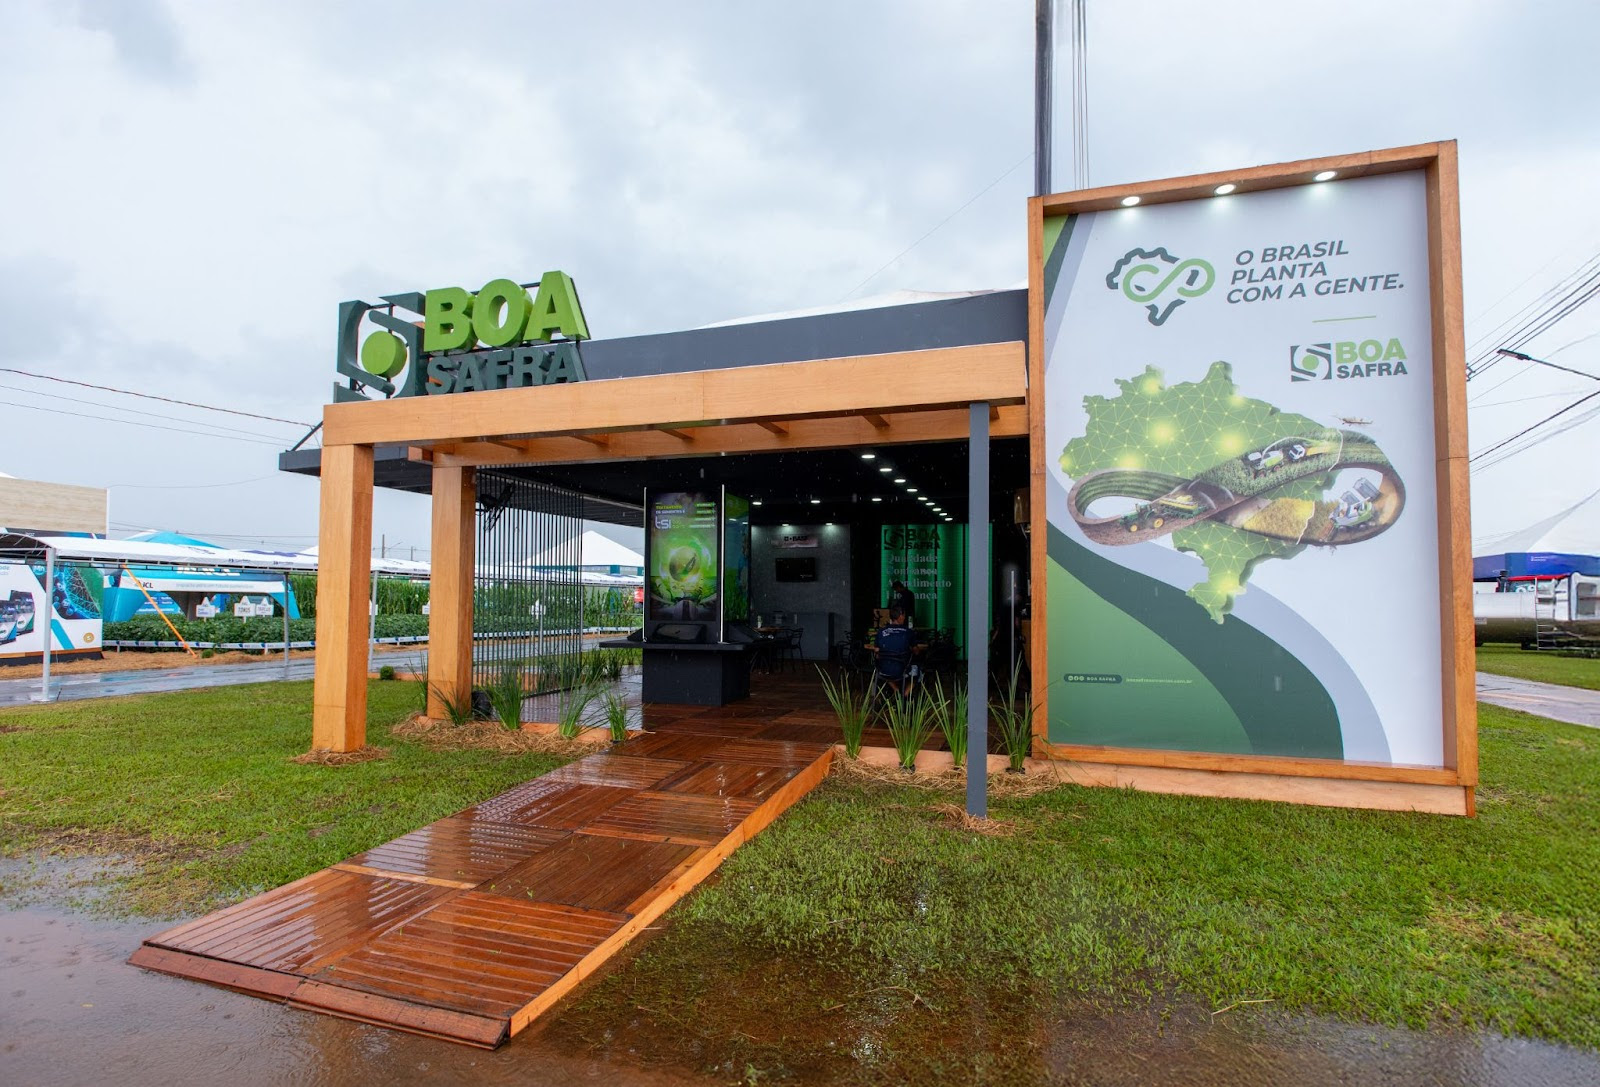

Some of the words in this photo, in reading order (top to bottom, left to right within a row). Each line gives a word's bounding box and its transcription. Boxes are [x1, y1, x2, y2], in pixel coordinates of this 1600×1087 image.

[1235, 249, 1254, 266] O
[1260, 239, 1349, 264] BRASIL
[1231, 261, 1328, 285] PLANTA
[1226, 284, 1284, 304] COM
[1288, 281, 1307, 299] A
[1313, 273, 1405, 296] GENTE.
[423, 270, 590, 354] BOA
[1335, 337, 1407, 364] BOA
[425, 343, 588, 395] SAFRA
[1336, 361, 1409, 379] SAFRA
[907, 528, 941, 541] BOA
[907, 541, 941, 550] SAFRA
